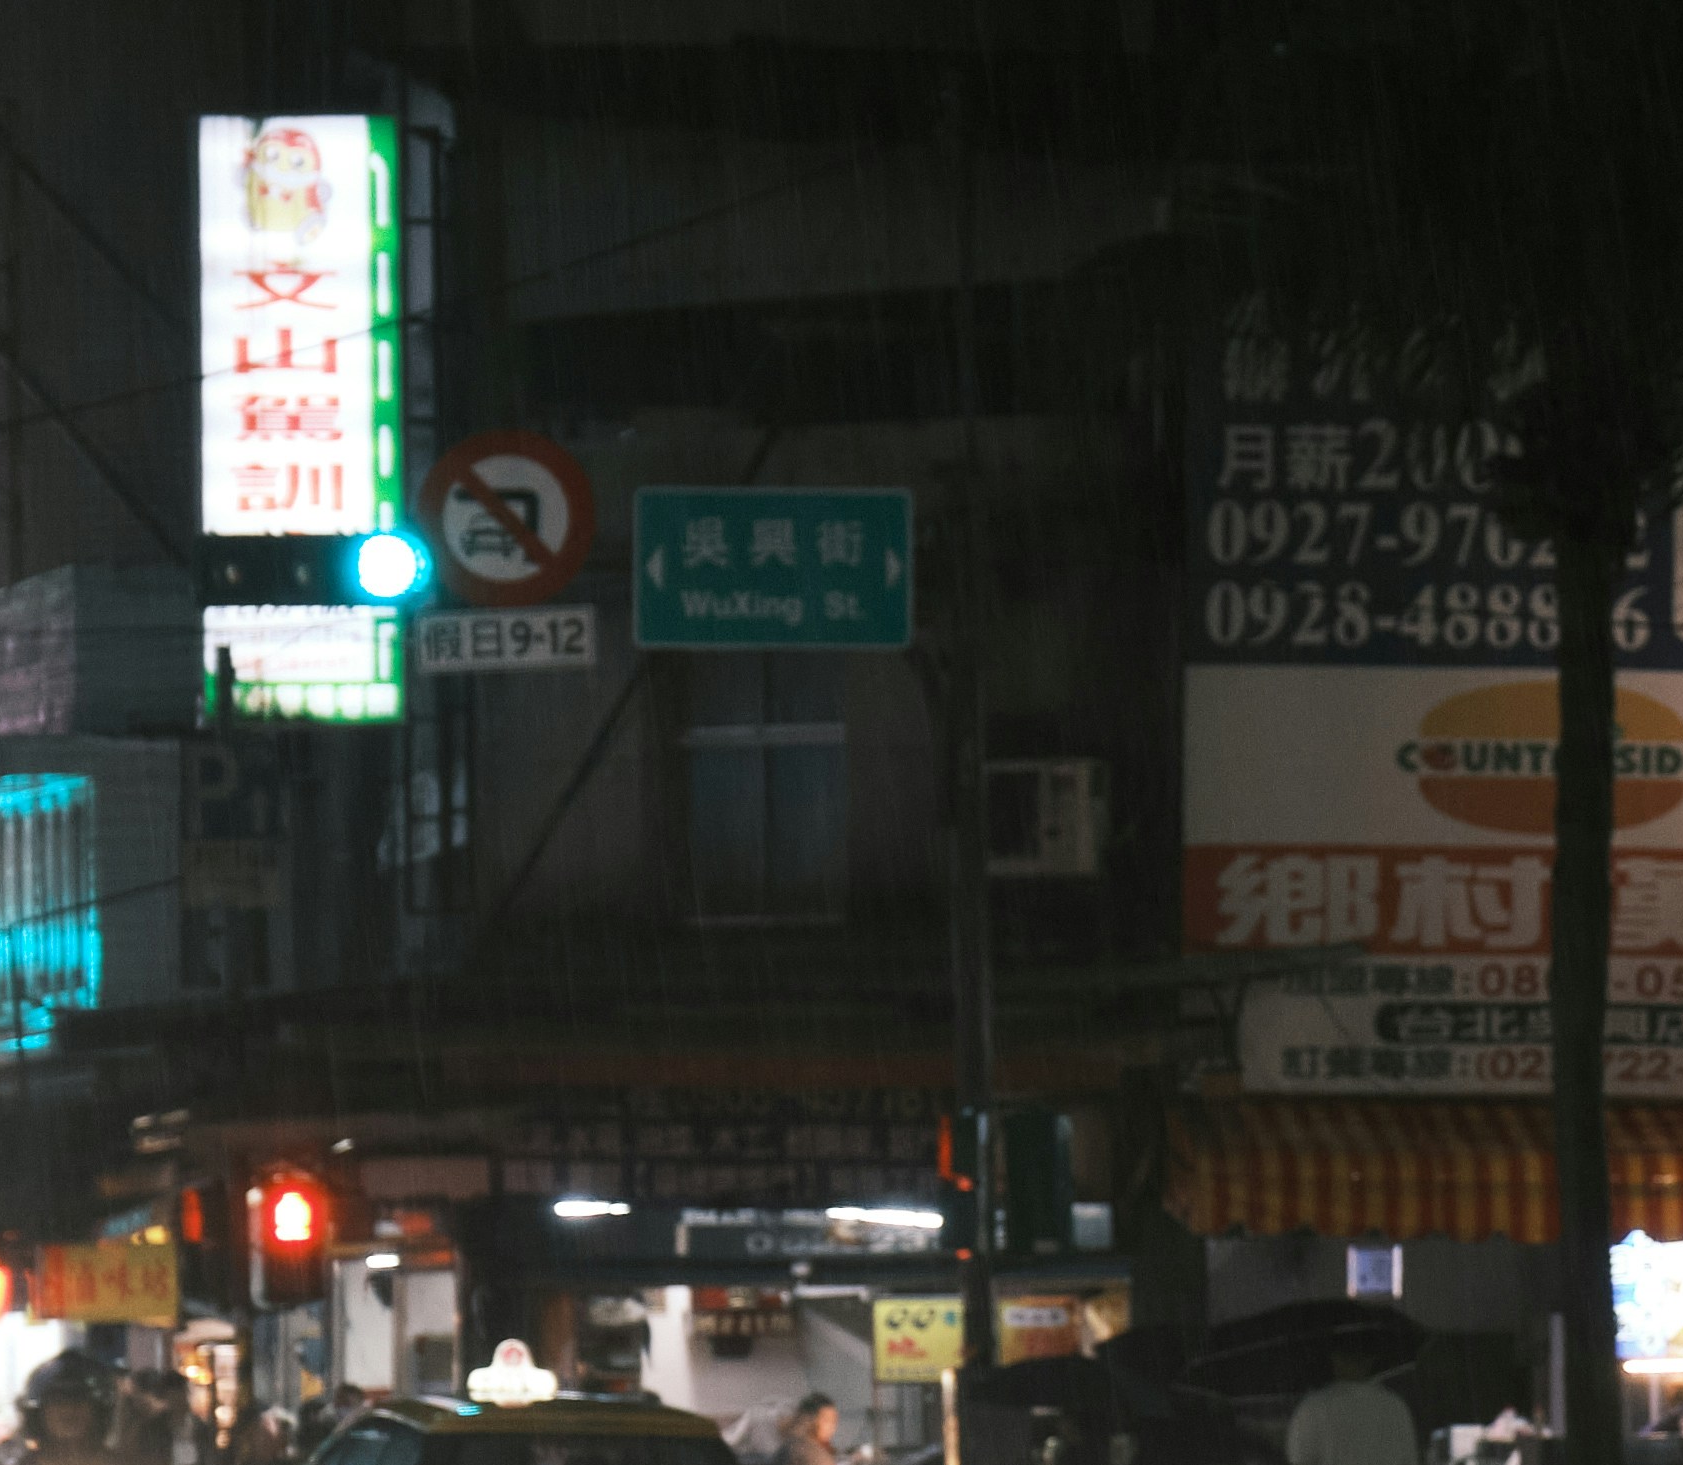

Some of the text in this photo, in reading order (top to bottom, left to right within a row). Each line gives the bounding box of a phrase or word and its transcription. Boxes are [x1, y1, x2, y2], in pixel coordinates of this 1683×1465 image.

[232, 260, 344, 512] 文山駕訓
[683, 517, 865, 568] 吳興街
[681, 590, 865, 626] WuXing St.
[1205, 578, 1652, 654] 0928-48886
